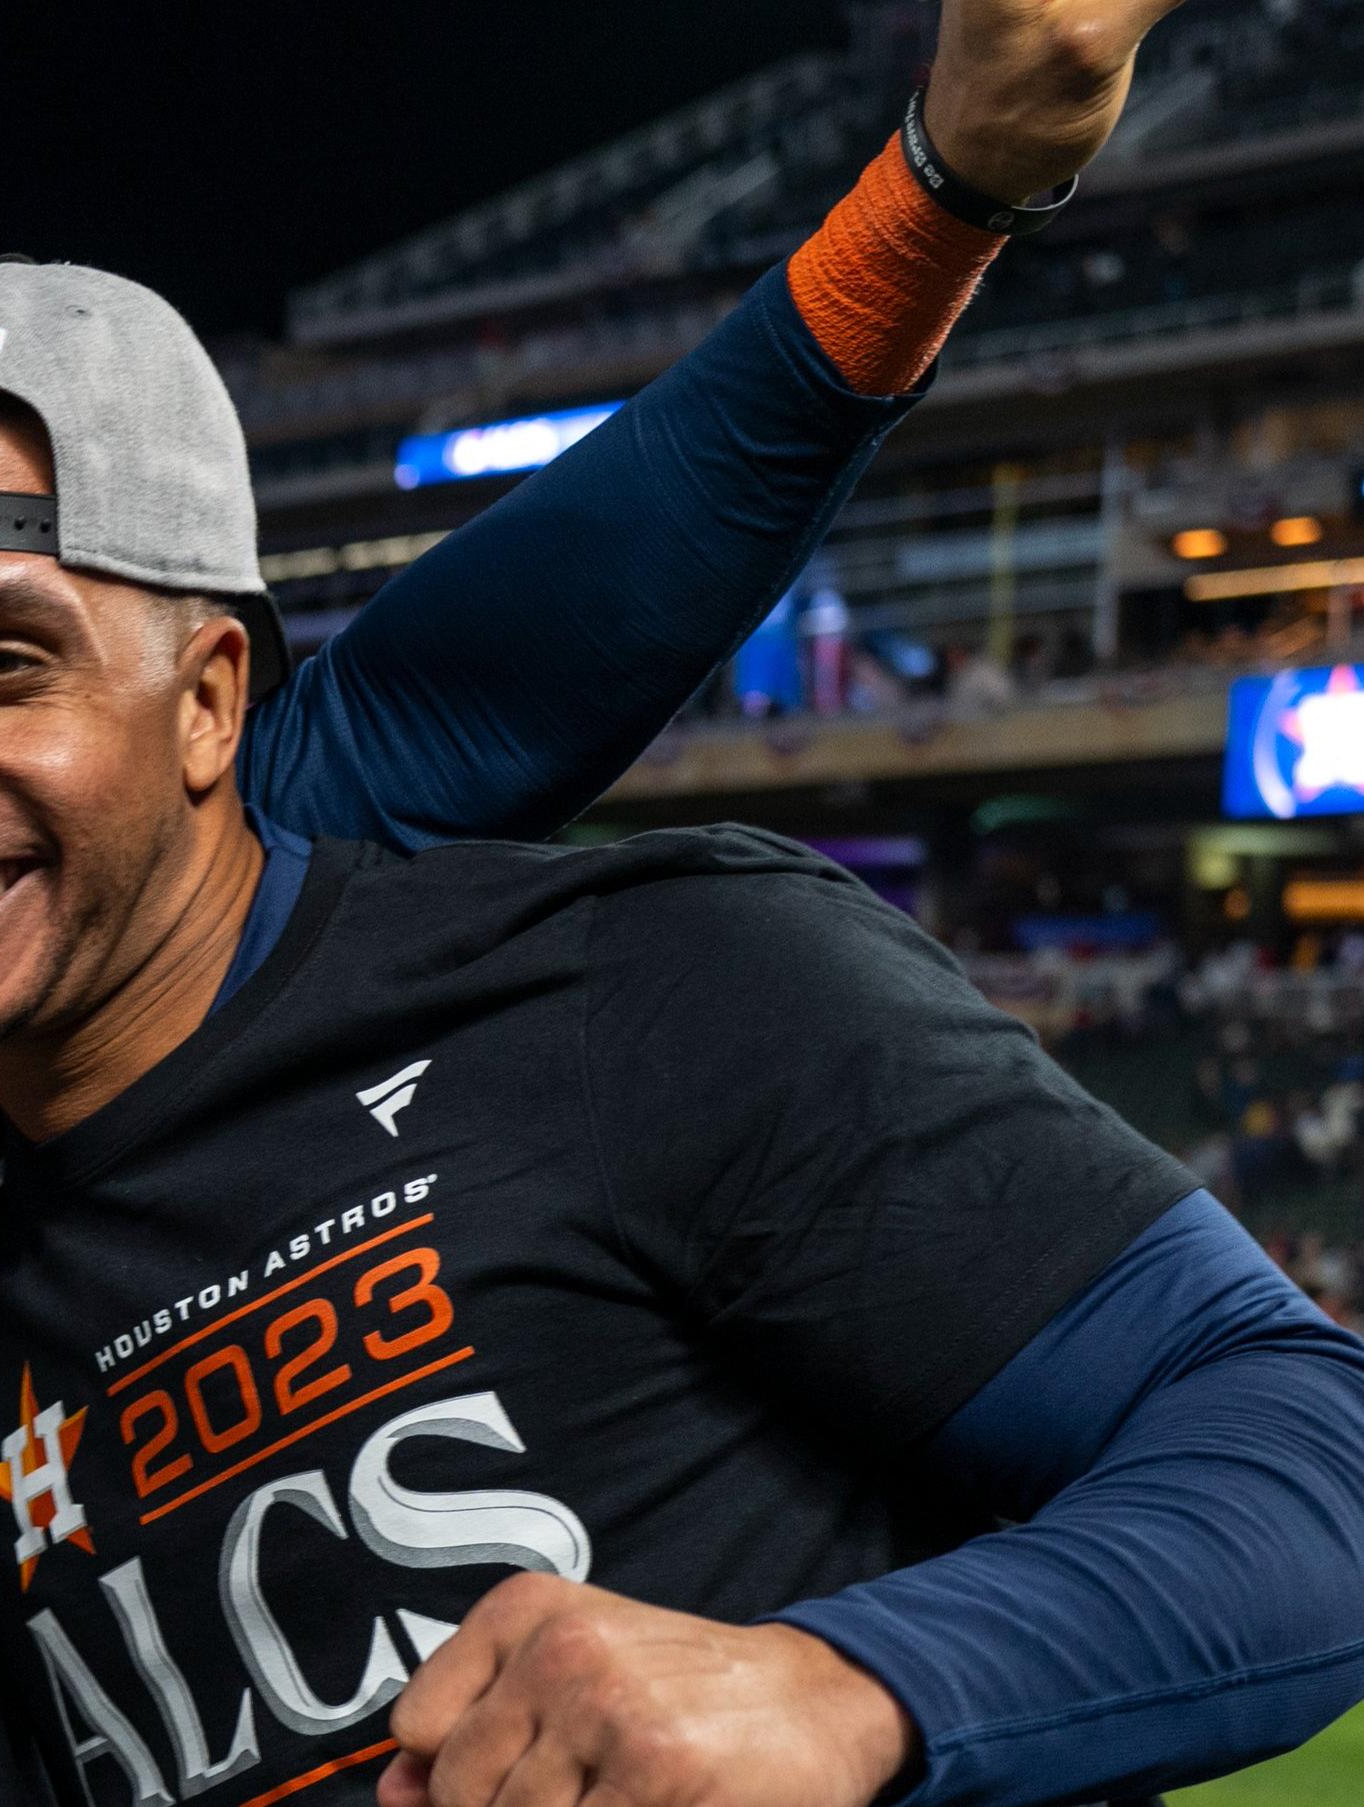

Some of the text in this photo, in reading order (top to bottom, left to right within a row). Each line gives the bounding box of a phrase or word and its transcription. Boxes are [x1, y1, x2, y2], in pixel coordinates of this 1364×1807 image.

[95, 1269, 250, 1373] HOUSTON
[118, 1246, 455, 1498] 2023
[25, 1390, 592, 1807] ALCS
